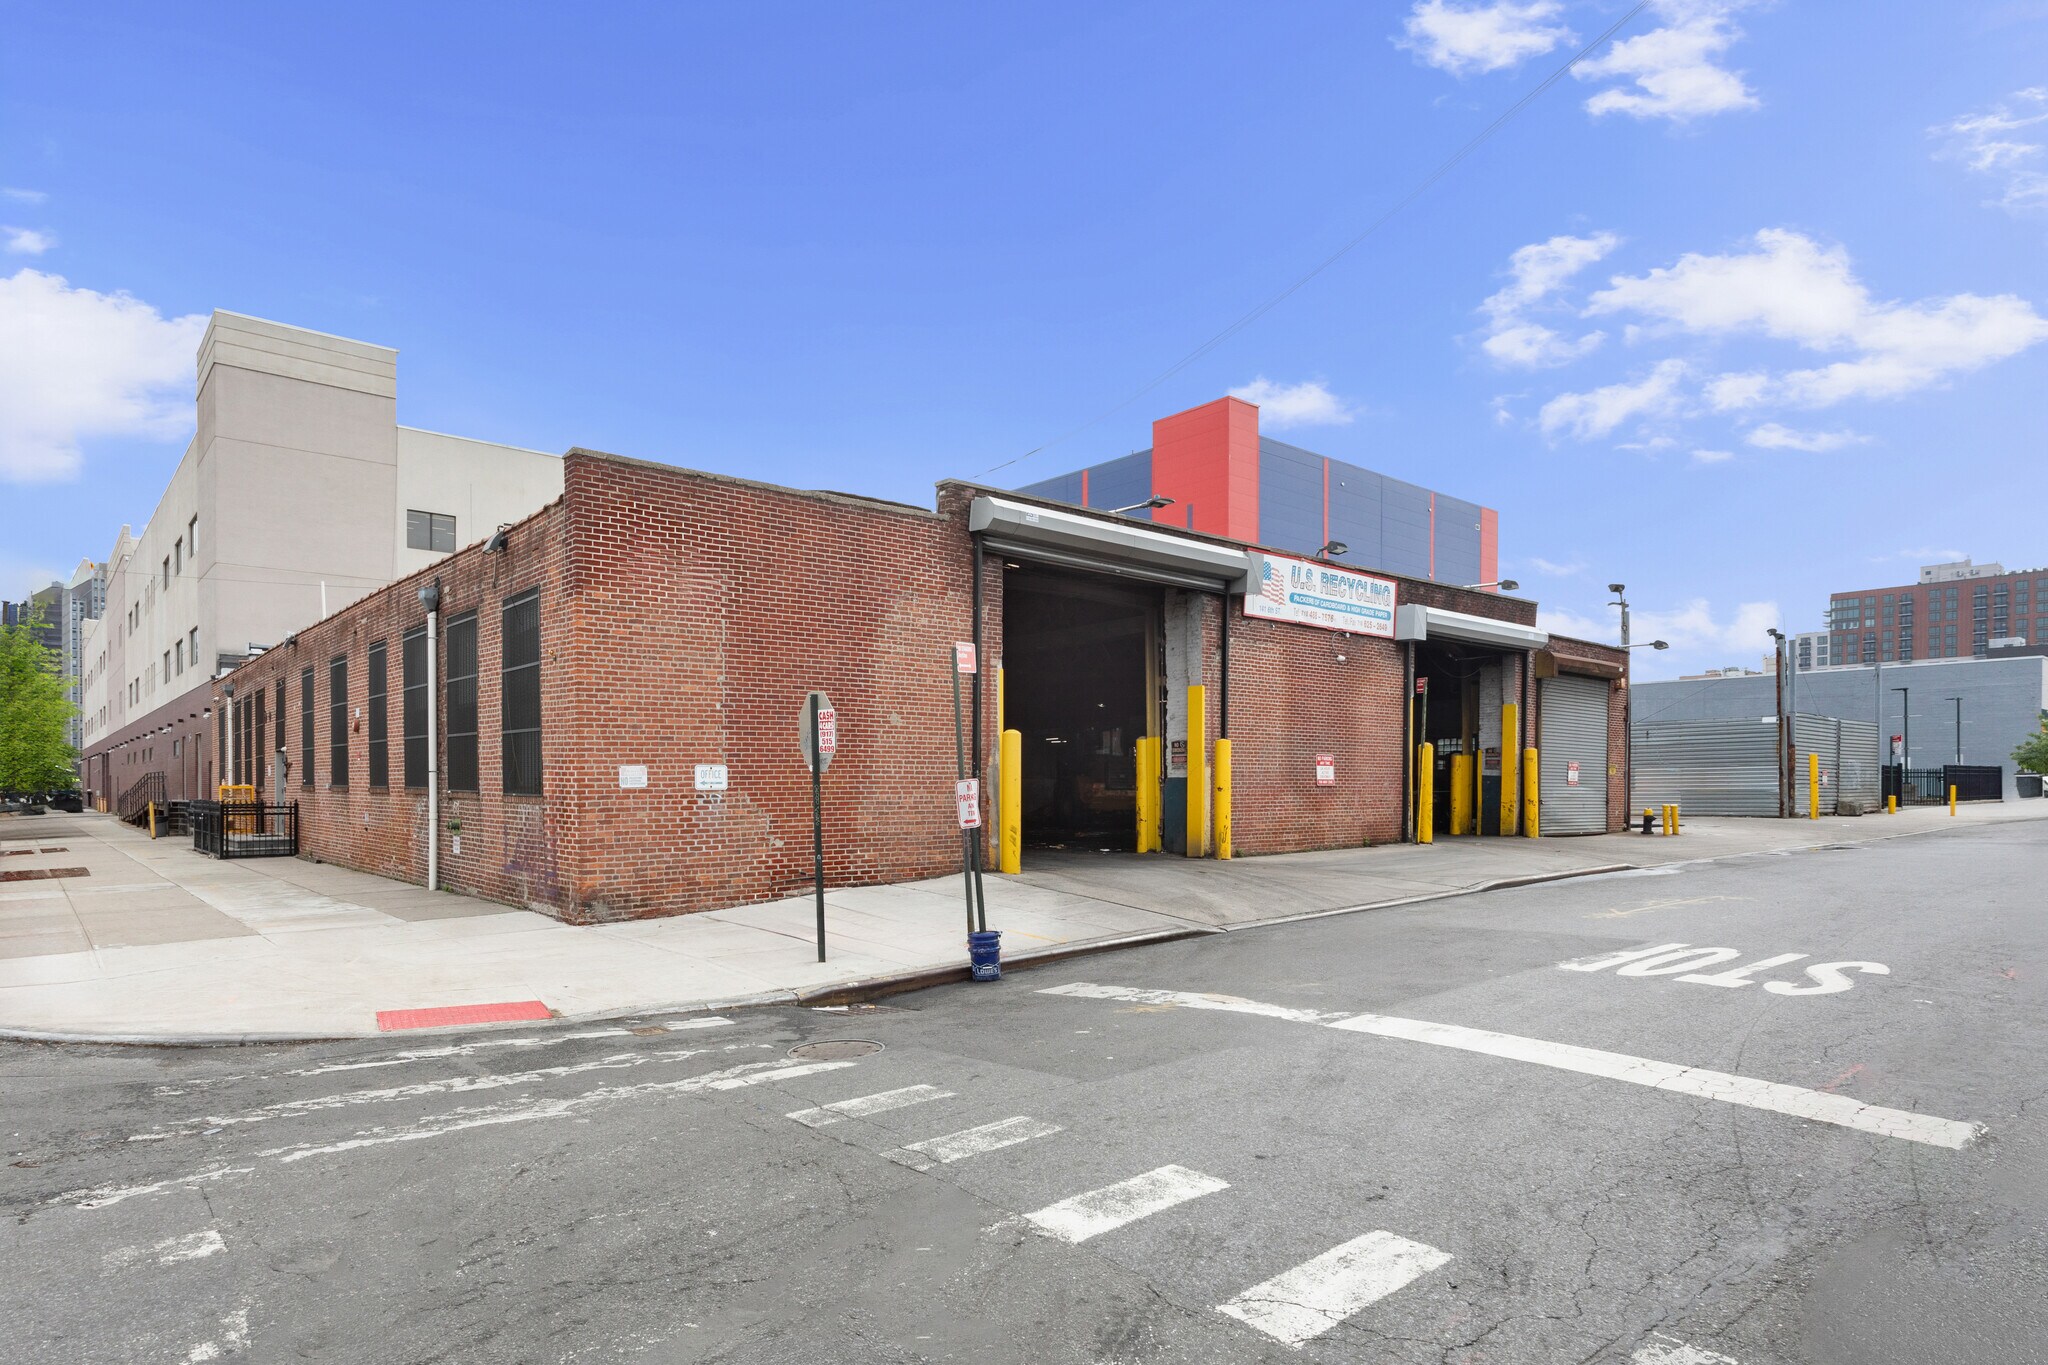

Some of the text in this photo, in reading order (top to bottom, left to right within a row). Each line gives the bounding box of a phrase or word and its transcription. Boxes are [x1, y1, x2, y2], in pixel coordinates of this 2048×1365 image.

[1291, 565, 1391, 607] U.S. RECYCLING
[1320, 599, 1347, 611] CARDBOARD
[1351, 605, 1361, 613] HIGH
[1361, 606, 1375, 616] GRADE
[1375, 609, 1388, 619] PAPER
[819, 745, 835, 753] 6499
[700, 769, 722, 779] OFFICE
